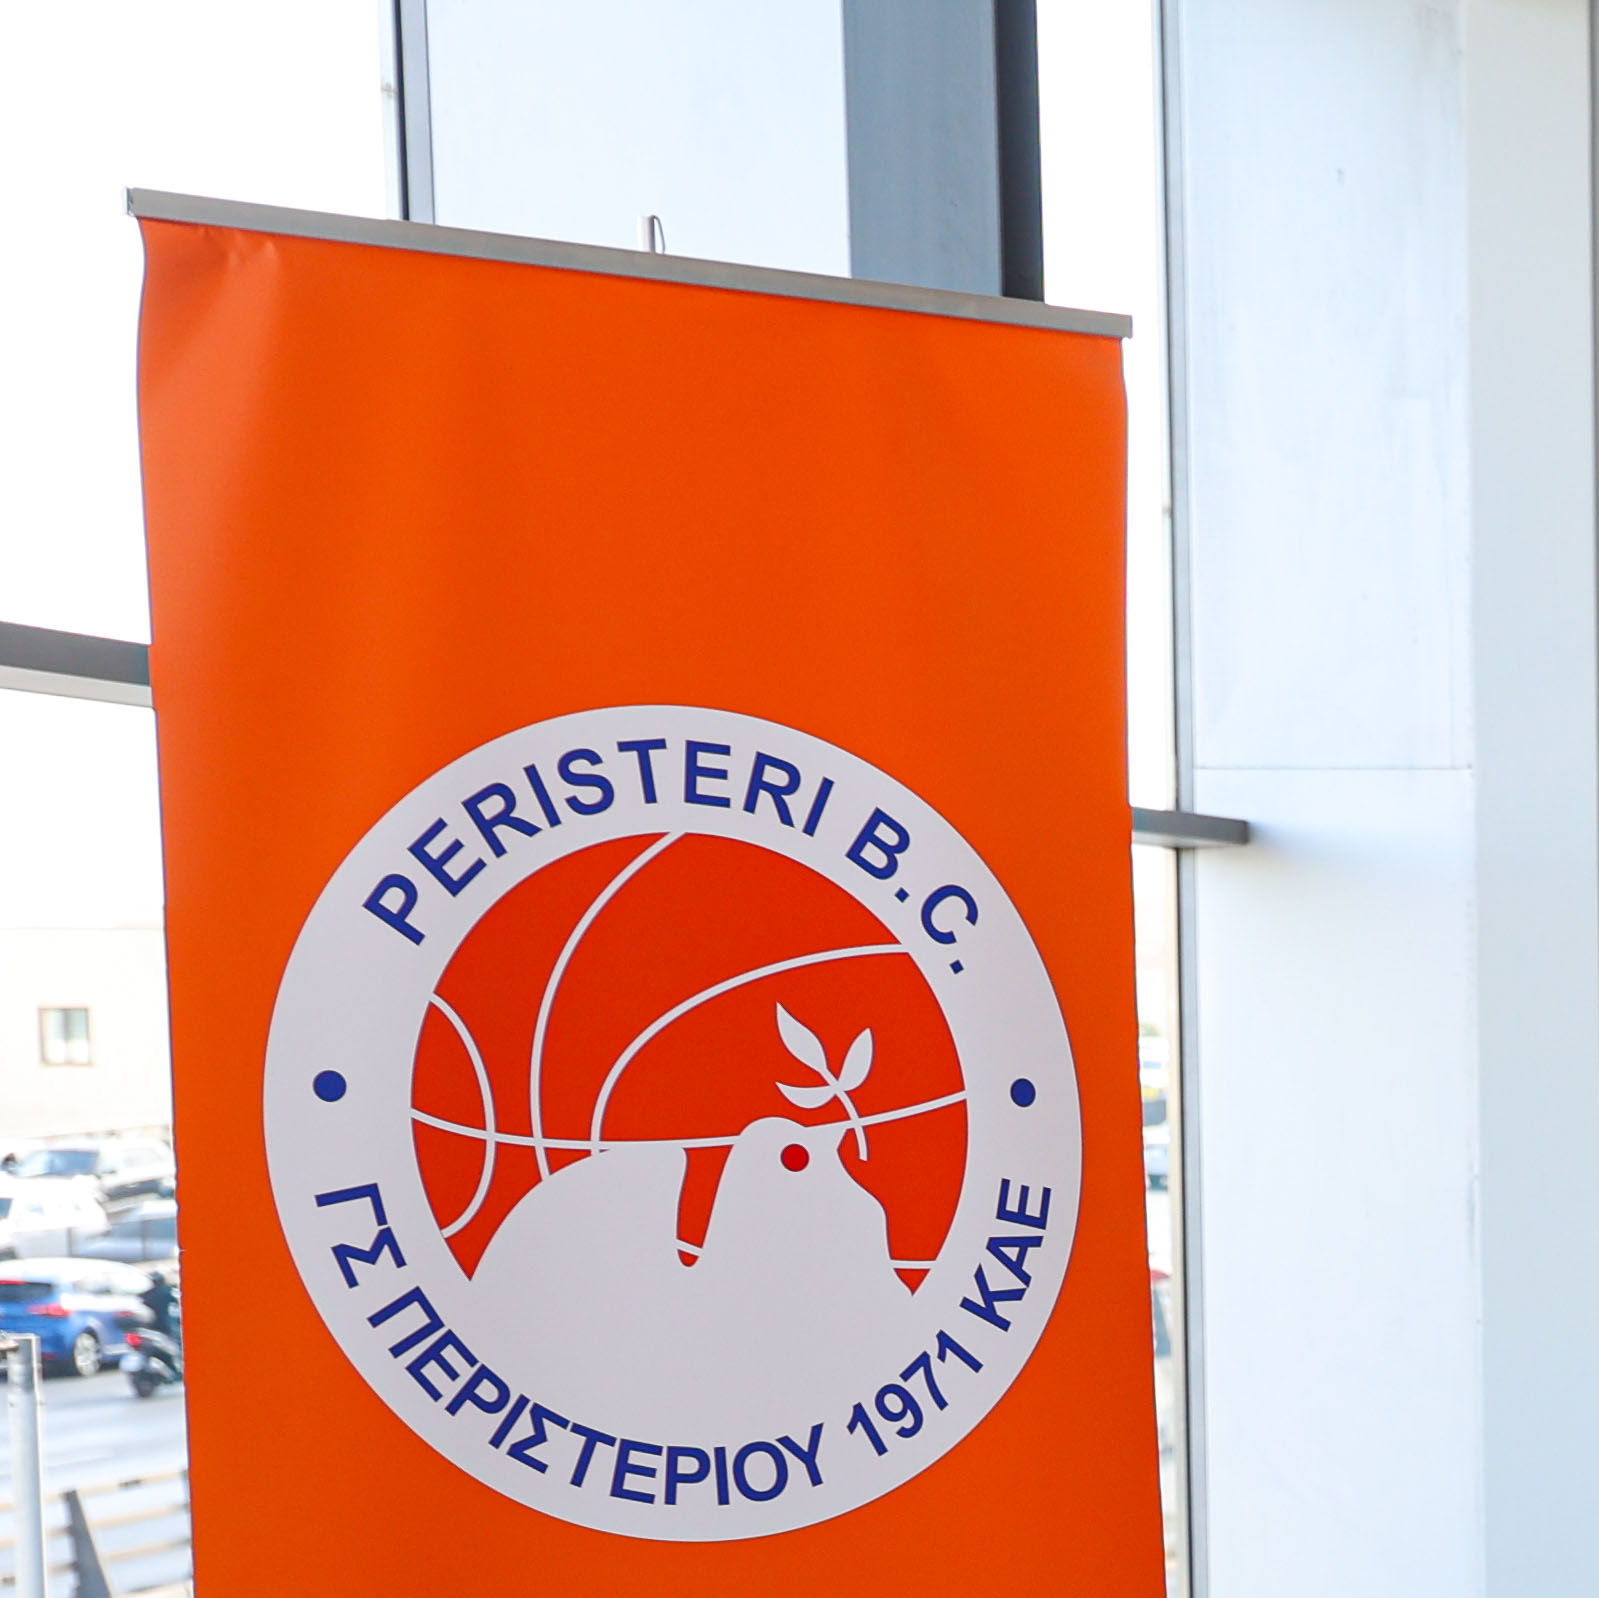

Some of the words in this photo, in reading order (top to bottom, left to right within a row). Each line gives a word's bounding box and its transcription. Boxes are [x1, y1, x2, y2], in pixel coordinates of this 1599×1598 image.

[365, 740, 832, 944] PERISTERI
[848, 810, 976, 972] B.C.
[318, 1185, 405, 1286] ΓΣ
[370, 1288, 821, 1504] ΠΕΡΙΣΤΕΡΙΟΥ
[849, 1332, 981, 1454] 1971
[962, 1181, 1049, 1329] ΚΑΕ
